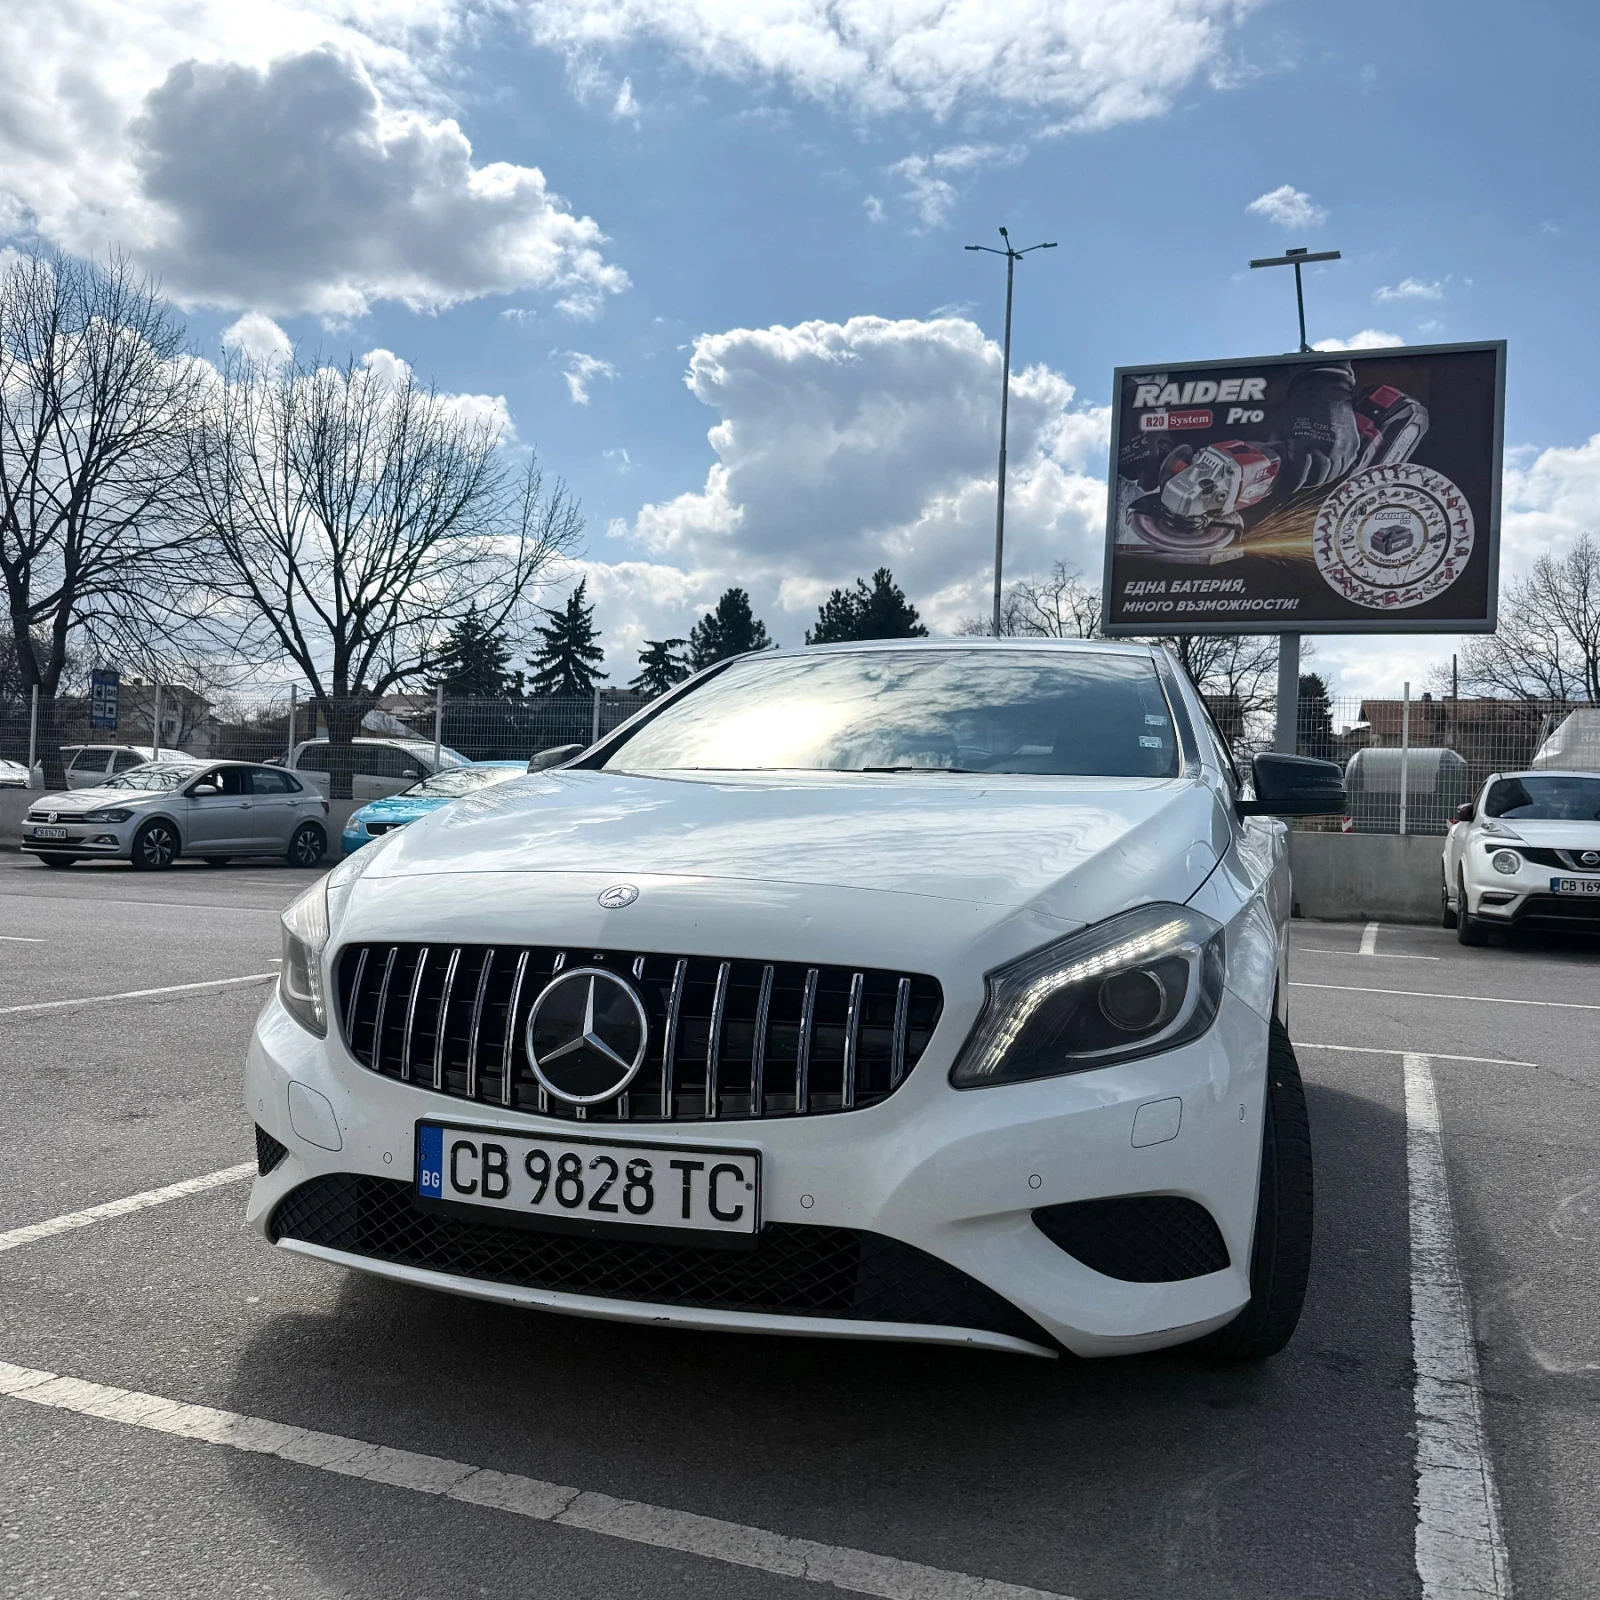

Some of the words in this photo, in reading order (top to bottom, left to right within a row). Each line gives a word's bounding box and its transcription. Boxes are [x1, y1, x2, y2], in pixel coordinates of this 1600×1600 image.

[1132, 377, 1267, 408] RAIDER
[1146, 416, 1165, 427] R20
[1170, 415, 1209, 426] System
[1226, 408, 1265, 424] Pro
[1375, 512, 1411, 520] RAIDER
[1124, 581, 1166, 595] ЕДНА
[1170, 579, 1247, 594] БАТЕРИЯ,
[1122, 601, 1173, 612] МНОГО
[1176, 598, 1300, 612] ВЪЗМОЖНОСТИ!
[1561, 880, 1577, 891] CB
[422, 1169, 440, 1188] BG
[450, 1140, 512, 1199] CB
[524, 1149, 655, 1215] 9828
[669, 1160, 744, 1222] TC
